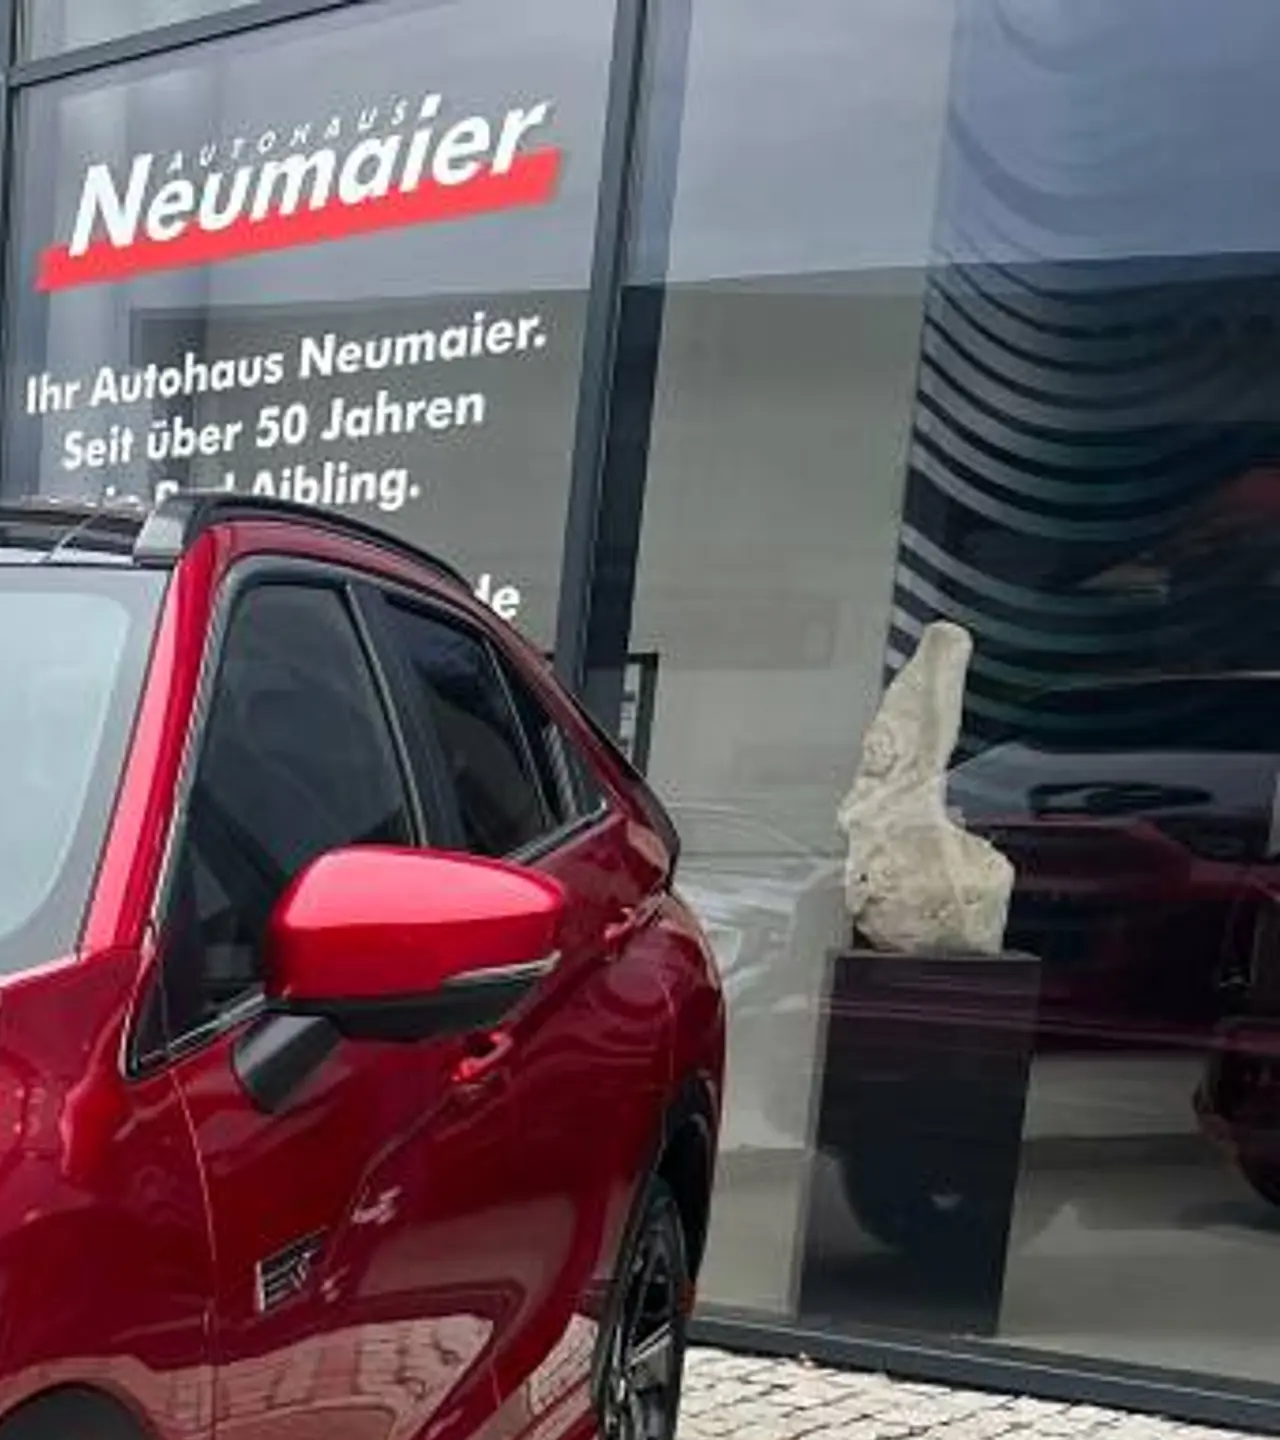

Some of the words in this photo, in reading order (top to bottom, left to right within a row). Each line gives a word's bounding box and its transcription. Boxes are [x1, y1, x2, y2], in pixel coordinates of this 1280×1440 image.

[68, 93, 553, 258] Neumaier
[166, 99, 409, 175] AUTOHAUS
[25, 372, 81, 415] Ihr
[89, 351, 285, 407] Autohaus
[298, 311, 548, 379] Neumaier.
[61, 424, 134, 470] Seit
[146, 415, 243, 459] über
[255, 402, 309, 448] 50
[319, 389, 486, 441] Jahren
[251, 461, 421, 511] Aibling.
